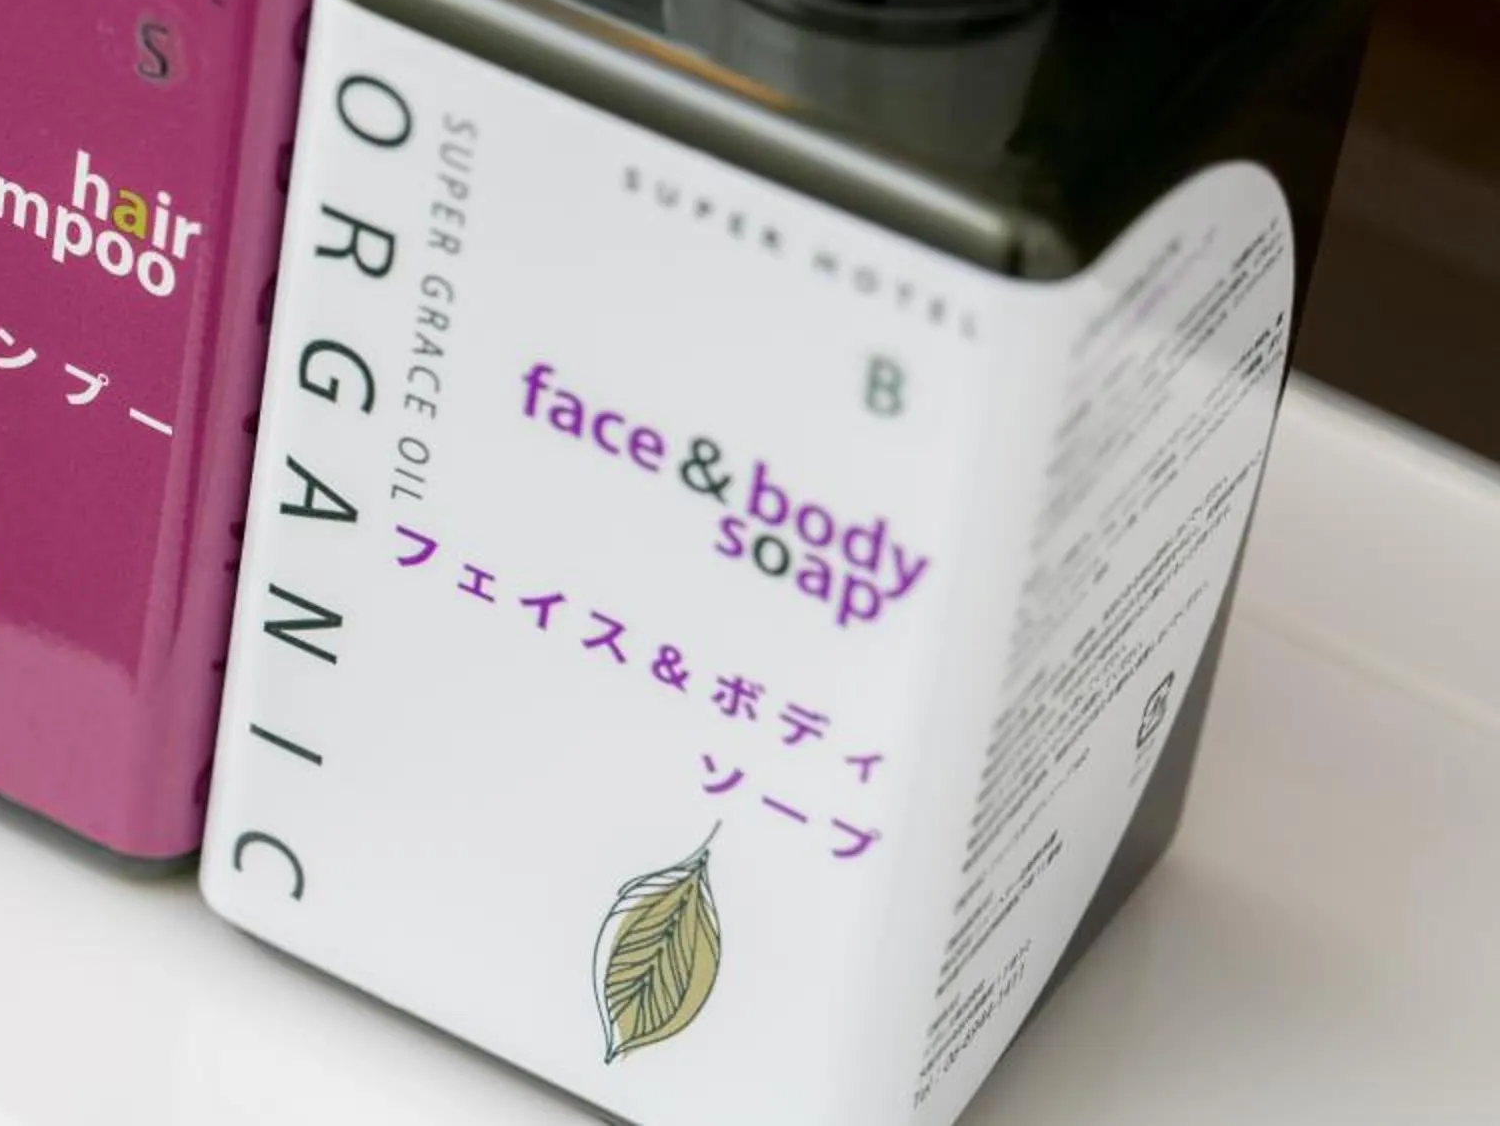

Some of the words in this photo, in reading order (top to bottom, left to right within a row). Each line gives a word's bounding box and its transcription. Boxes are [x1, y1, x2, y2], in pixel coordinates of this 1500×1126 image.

[135, 21, 169, 82] S
[72, 149, 203, 261] hair
[426, 112, 479, 258] SUPER
[622, 165, 786, 256] SUPER
[402, 273, 457, 421] GRACE
[864, 353, 906, 419] B
[232, 74, 414, 902] ORGANIC
[390, 436, 432, 503] OIL
[520, 362, 667, 473] face
[678, 436, 735, 506] &
[746, 460, 932, 602] body
[714, 512, 886, 629] soap
[700, 753, 885, 862] ソープ
